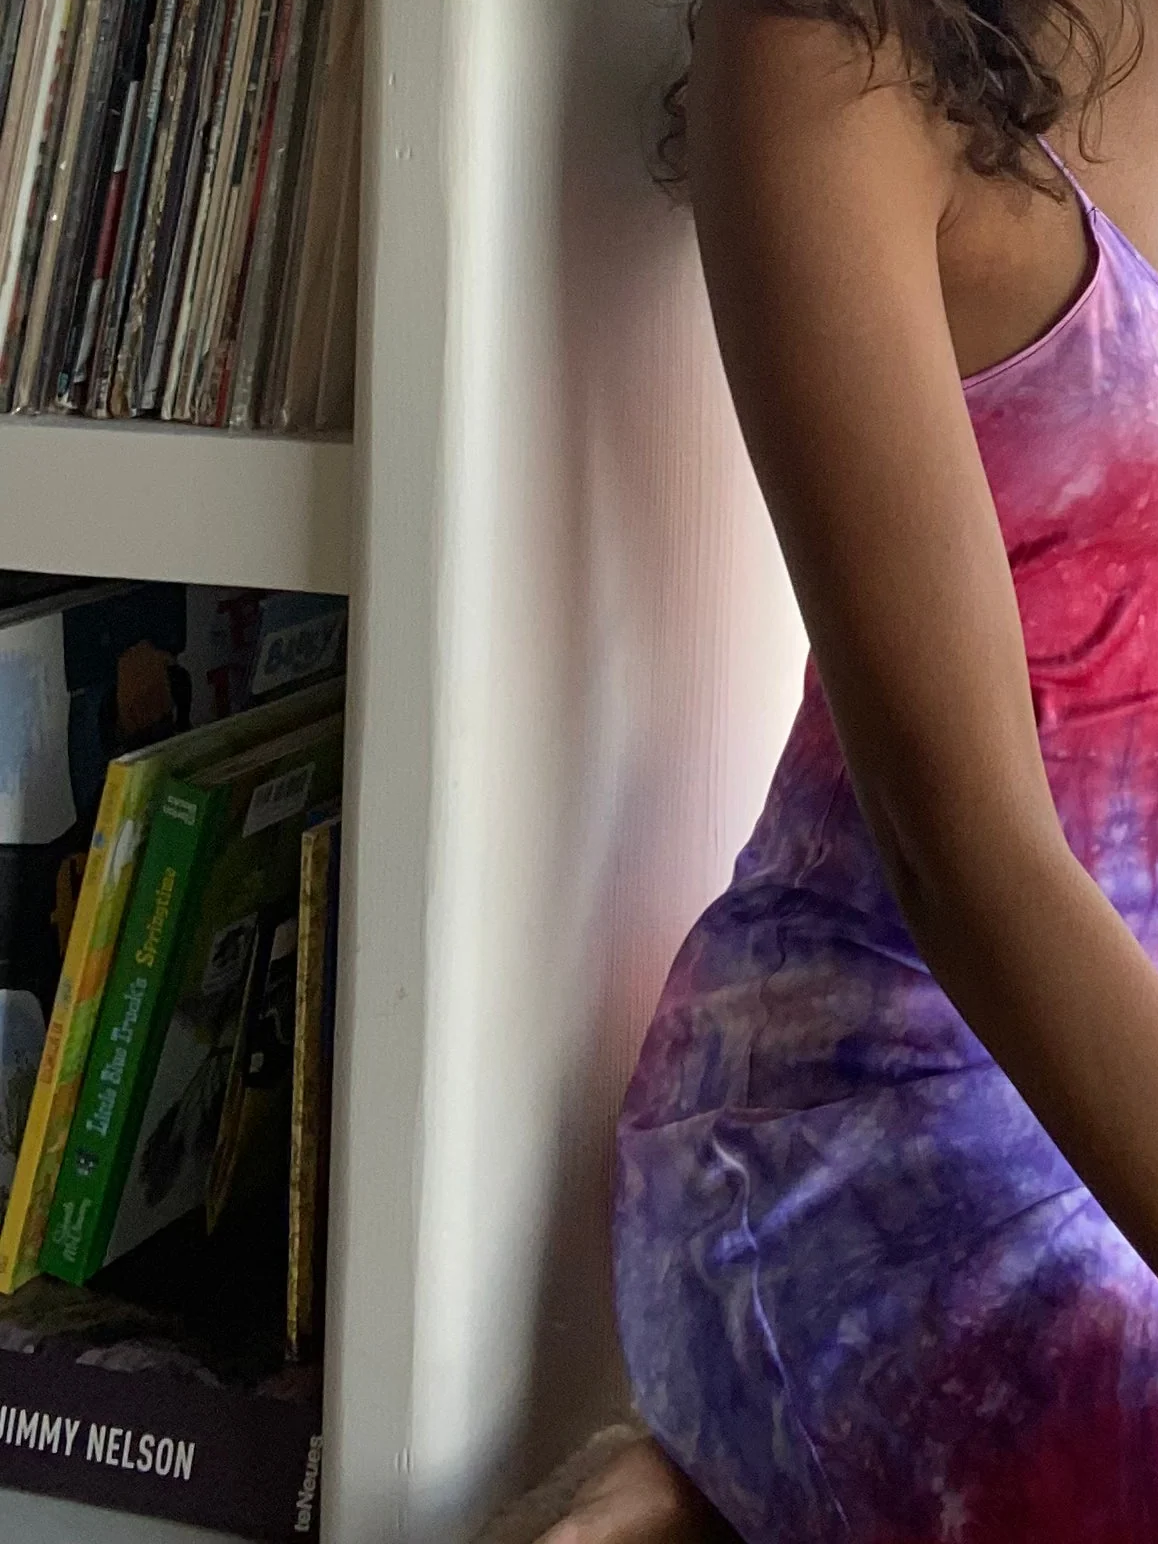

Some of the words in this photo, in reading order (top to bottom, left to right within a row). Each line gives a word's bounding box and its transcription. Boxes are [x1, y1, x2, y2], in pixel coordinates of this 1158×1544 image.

[136, 867, 176, 967] Springtime
[86, 1422, 196, 1481] NELSON
[294, 1434, 323, 1532] teNeues
